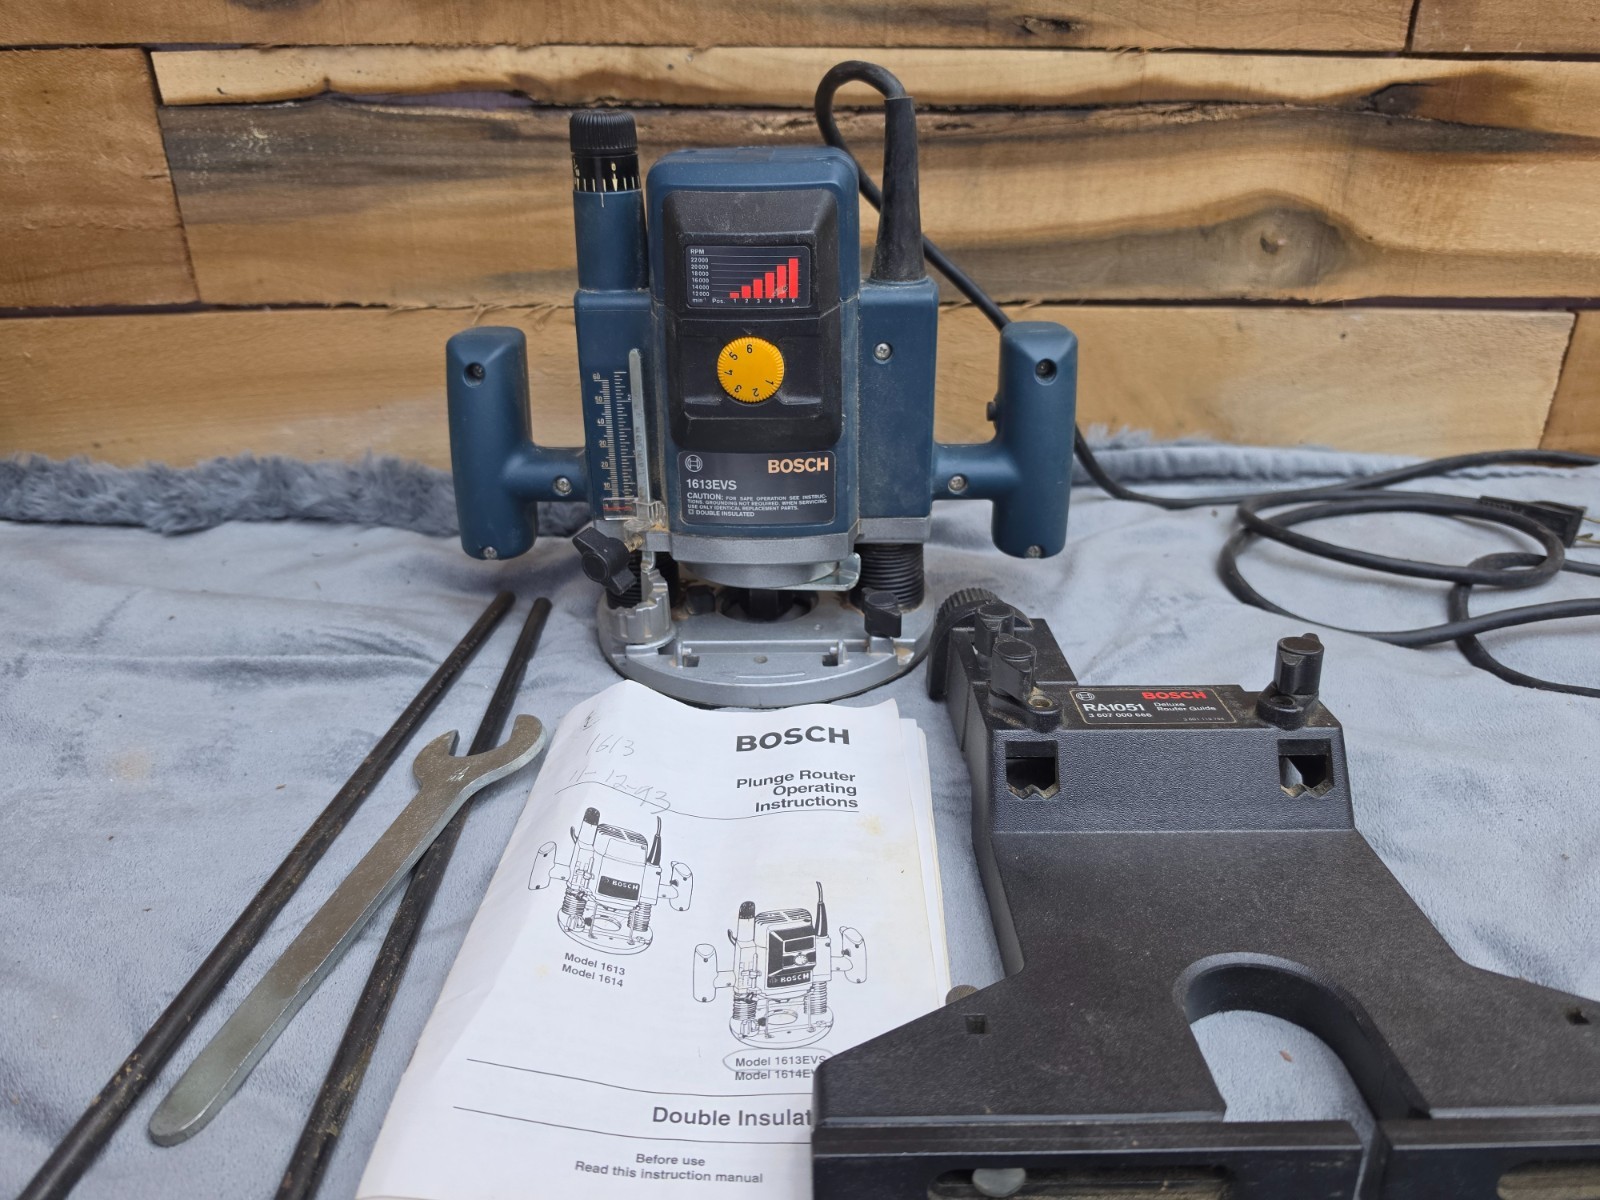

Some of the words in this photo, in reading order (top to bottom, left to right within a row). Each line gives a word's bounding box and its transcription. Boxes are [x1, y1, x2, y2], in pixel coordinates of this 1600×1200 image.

[746, 344, 752, 353] 6
[729, 352, 738, 360] 5
[752, 388, 759, 397] 2
[768, 457, 829, 474] BOSCH
[686, 479, 737, 490] 1613EVS
[1142, 691, 1207, 700] BOSCH
[1082, 703, 1146, 712] RA1051
[586, 733, 635, 756] 1613
[736, 726, 850, 752] BOSCH
[737, 772, 794, 788] Plunge
[799, 769, 856, 782] Router
[773, 783, 857, 797] Operating
[755, 796, 858, 812] Instructions
[612, 880, 638, 890] BOSCH
[564, 953, 597, 968] Model
[601, 962, 626, 976] 1613
[562, 964, 595, 980] Model
[598, 974, 624, 987] 1614
[780, 972, 810, 983] BOSCH
[735, 1057, 771, 1067] Model
[775, 1055, 826, 1065] 1613EVS
[735, 1070, 770, 1081] Model
[653, 1106, 730, 1126] Double
[738, 1109, 812, 1126] Insulat
[636, 1154, 678, 1165] Before
[683, 1156, 705, 1166] use
[575, 1161, 608, 1175] Read
[612, 1166, 636, 1178] this
[641, 1170, 711, 1182] instruction
[716, 1173, 763, 1183] manual
